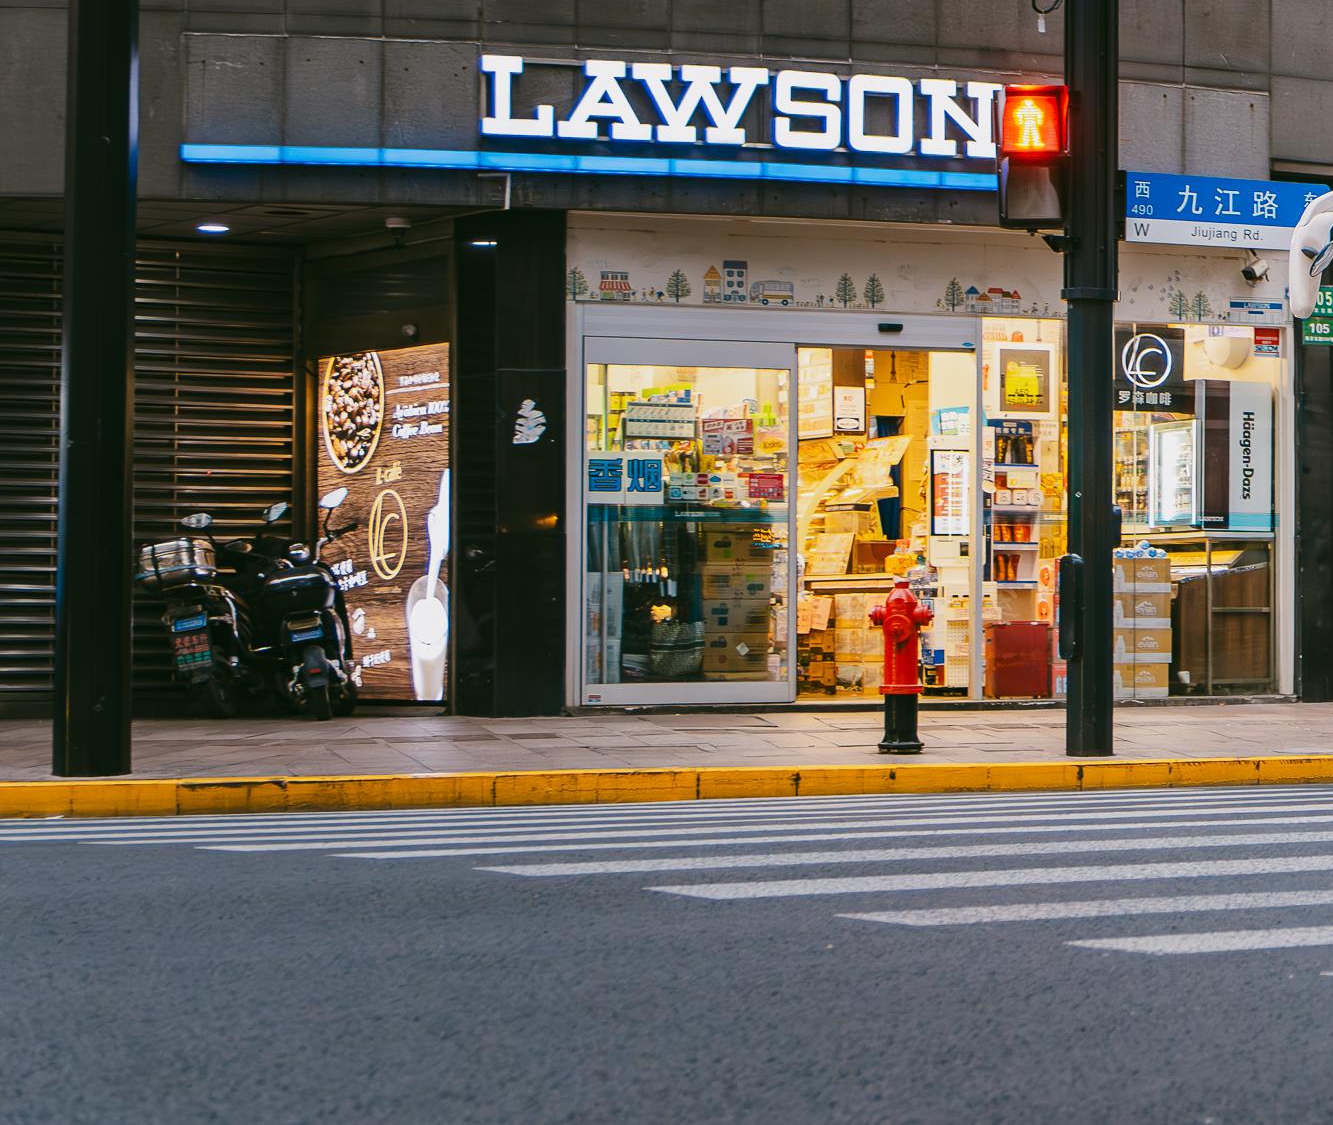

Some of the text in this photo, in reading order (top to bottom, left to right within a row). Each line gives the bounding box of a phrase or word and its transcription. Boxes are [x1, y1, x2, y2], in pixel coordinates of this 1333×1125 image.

[480, 54, 1001, 159] LAWSON
[1131, 204, 1154, 216] 490
[1134, 180, 1151, 200] 西
[1176, 184, 1279, 220] 九江路
[1134, 223, 1264, 243] W Jiujiang Rd.
[1309, 323, 1330, 334] 105
[588, 458, 662, 492] 香烟
[1137, 639, 1159, 650] evian
